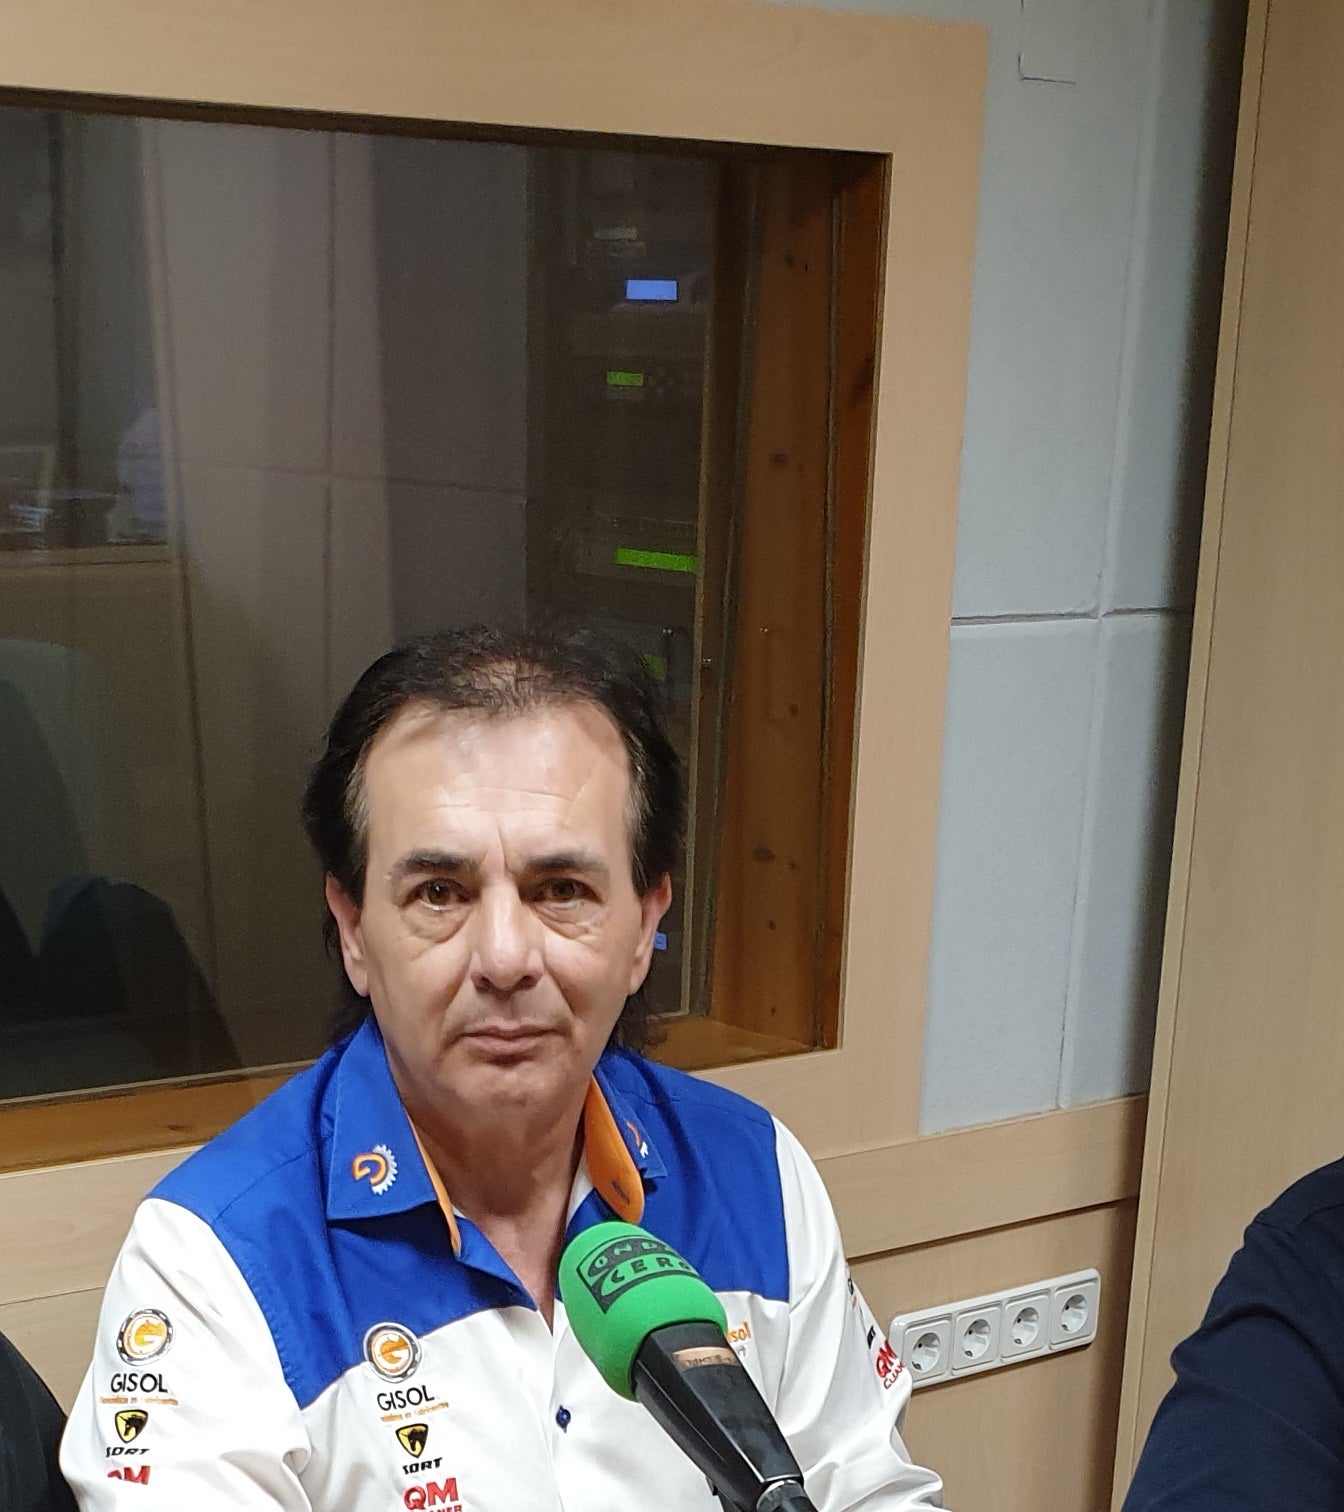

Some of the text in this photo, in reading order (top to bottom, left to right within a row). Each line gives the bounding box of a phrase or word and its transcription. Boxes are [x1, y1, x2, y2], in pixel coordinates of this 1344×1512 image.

[594, 1241, 671, 1269] OND
[727, 1321, 751, 1343] sol
[110, 1372, 169, 1394] GISOL
[376, 1384, 435, 1412] GISOL
[403, 1477, 459, 1511] QM
